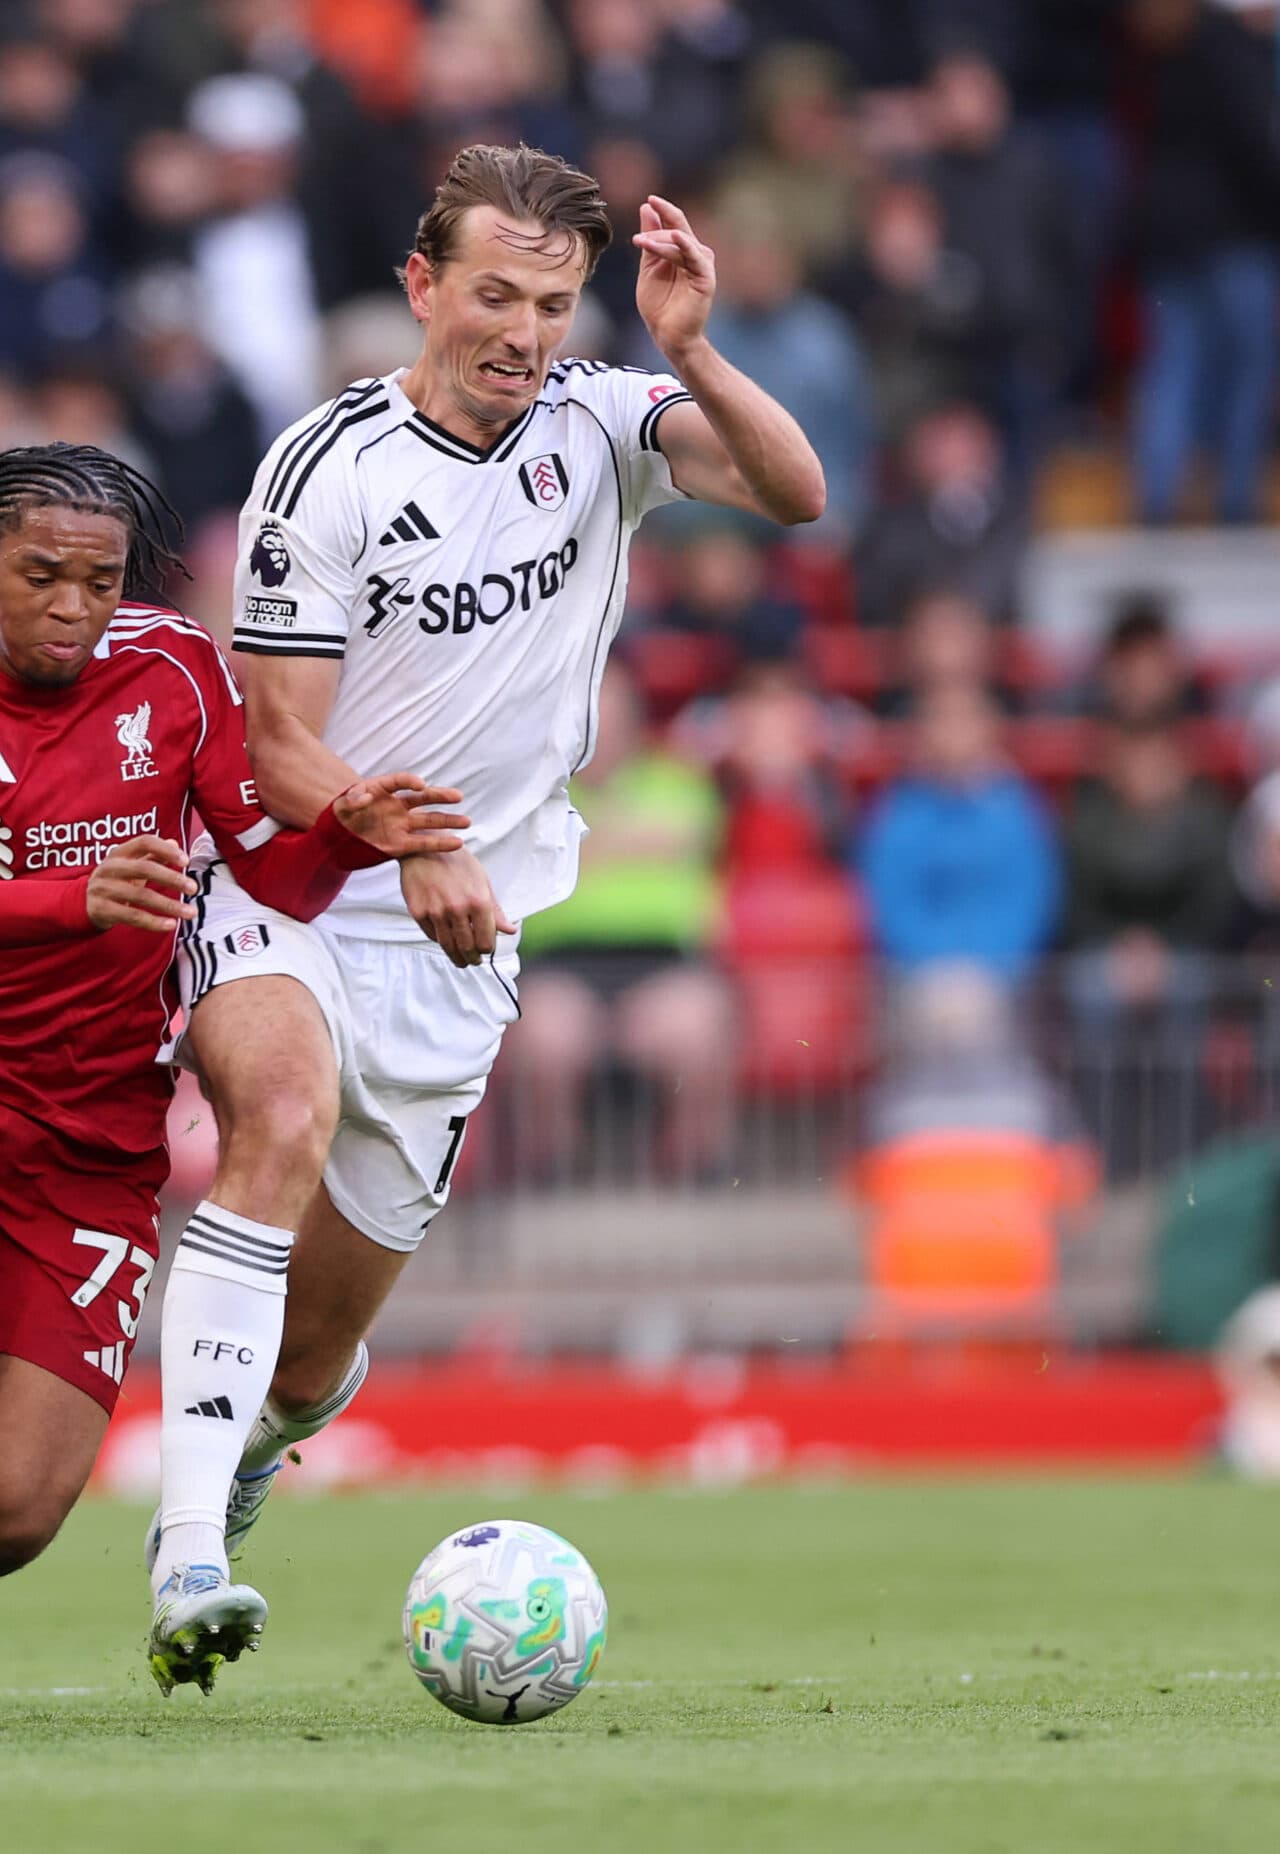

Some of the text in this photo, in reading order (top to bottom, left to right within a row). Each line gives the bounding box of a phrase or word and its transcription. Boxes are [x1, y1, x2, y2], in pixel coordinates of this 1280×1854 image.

[532, 462, 558, 501] FFC
[418, 537, 579, 635] SBOTOP
[258, 600, 292, 615] room
[25, 805, 158, 848] standard
[25, 839, 124, 870] chart
[70, 1228, 157, 1339] 73
[192, 1339, 254, 1365] FFC
